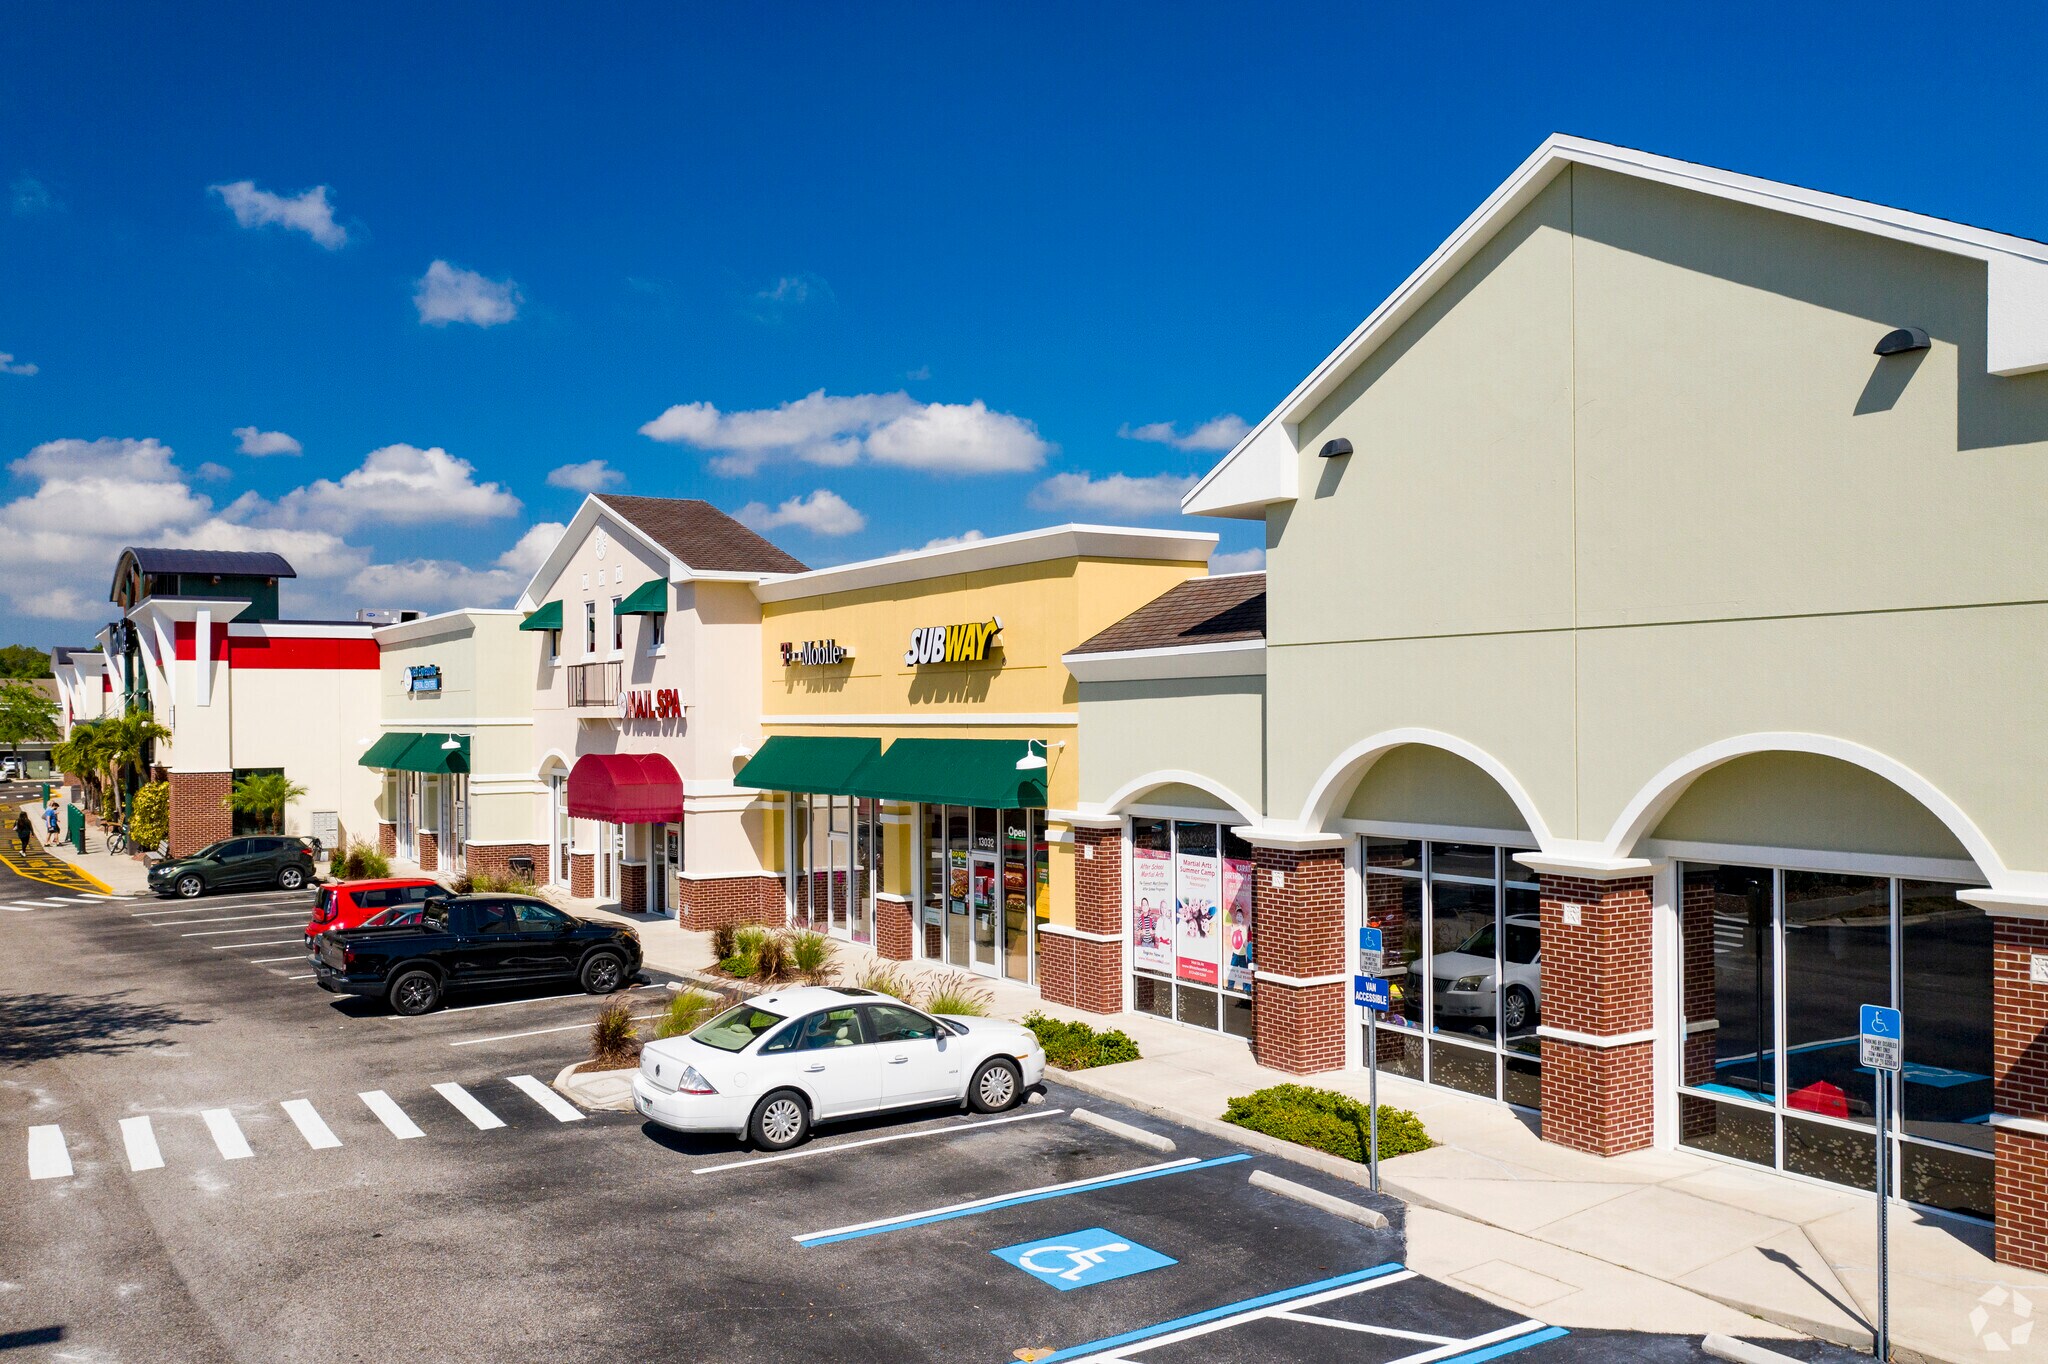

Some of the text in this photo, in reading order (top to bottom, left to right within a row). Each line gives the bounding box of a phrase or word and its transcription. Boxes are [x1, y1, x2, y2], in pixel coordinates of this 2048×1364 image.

[904, 616, 1001, 666] SUBWAY
[627, 689, 682, 718] NAIL SPA
[1008, 826, 1027, 838] Open
[1183, 859, 1200, 867] Martial
[1180, 866, 1215, 877] Summer Camp
[1365, 982, 1377, 993] VAN
[1355, 990, 1387, 1005] ACCESSIBLE
[1882, 1041, 1897, 1049] DISABLED
